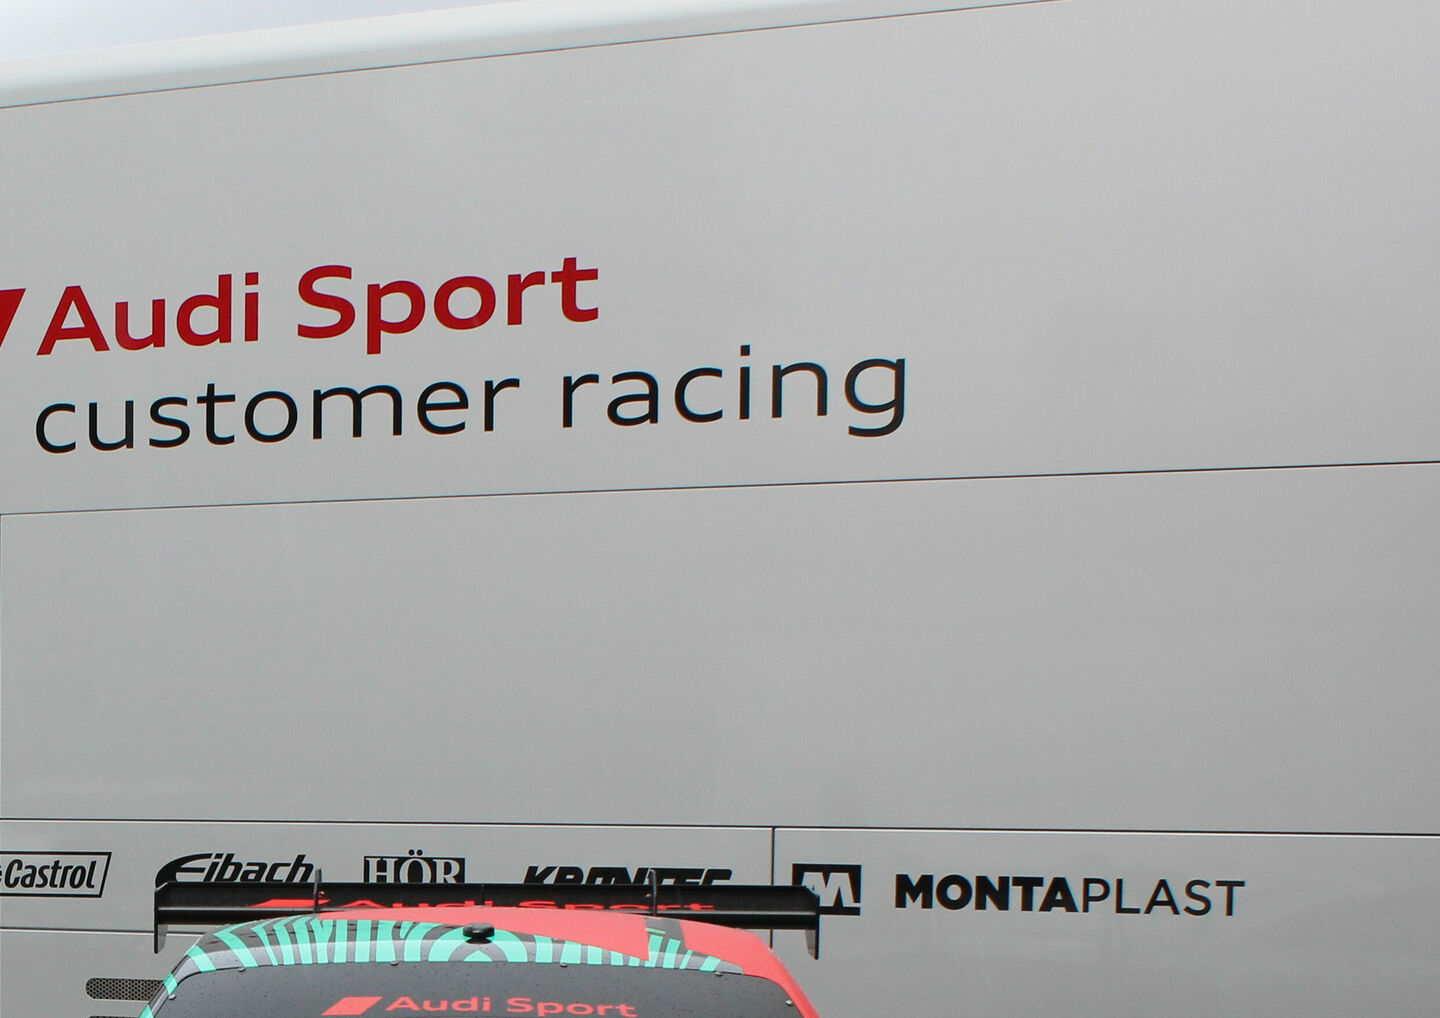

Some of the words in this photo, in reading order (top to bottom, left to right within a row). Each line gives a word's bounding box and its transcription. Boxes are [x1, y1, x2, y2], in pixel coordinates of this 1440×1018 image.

[36, 271, 260, 356] Audi
[296, 256, 600, 355] Sport
[34, 374, 521, 455] customer
[562, 344, 907, 437] racing
[4, 859, 97, 889] Castrol
[155, 853, 314, 883] Eibach
[364, 849, 466, 884] HÖR
[895, 873, 1246, 917] MONTAPLAST
[385, 996, 491, 1012] Audi
[506, 997, 637, 1017] Sport
